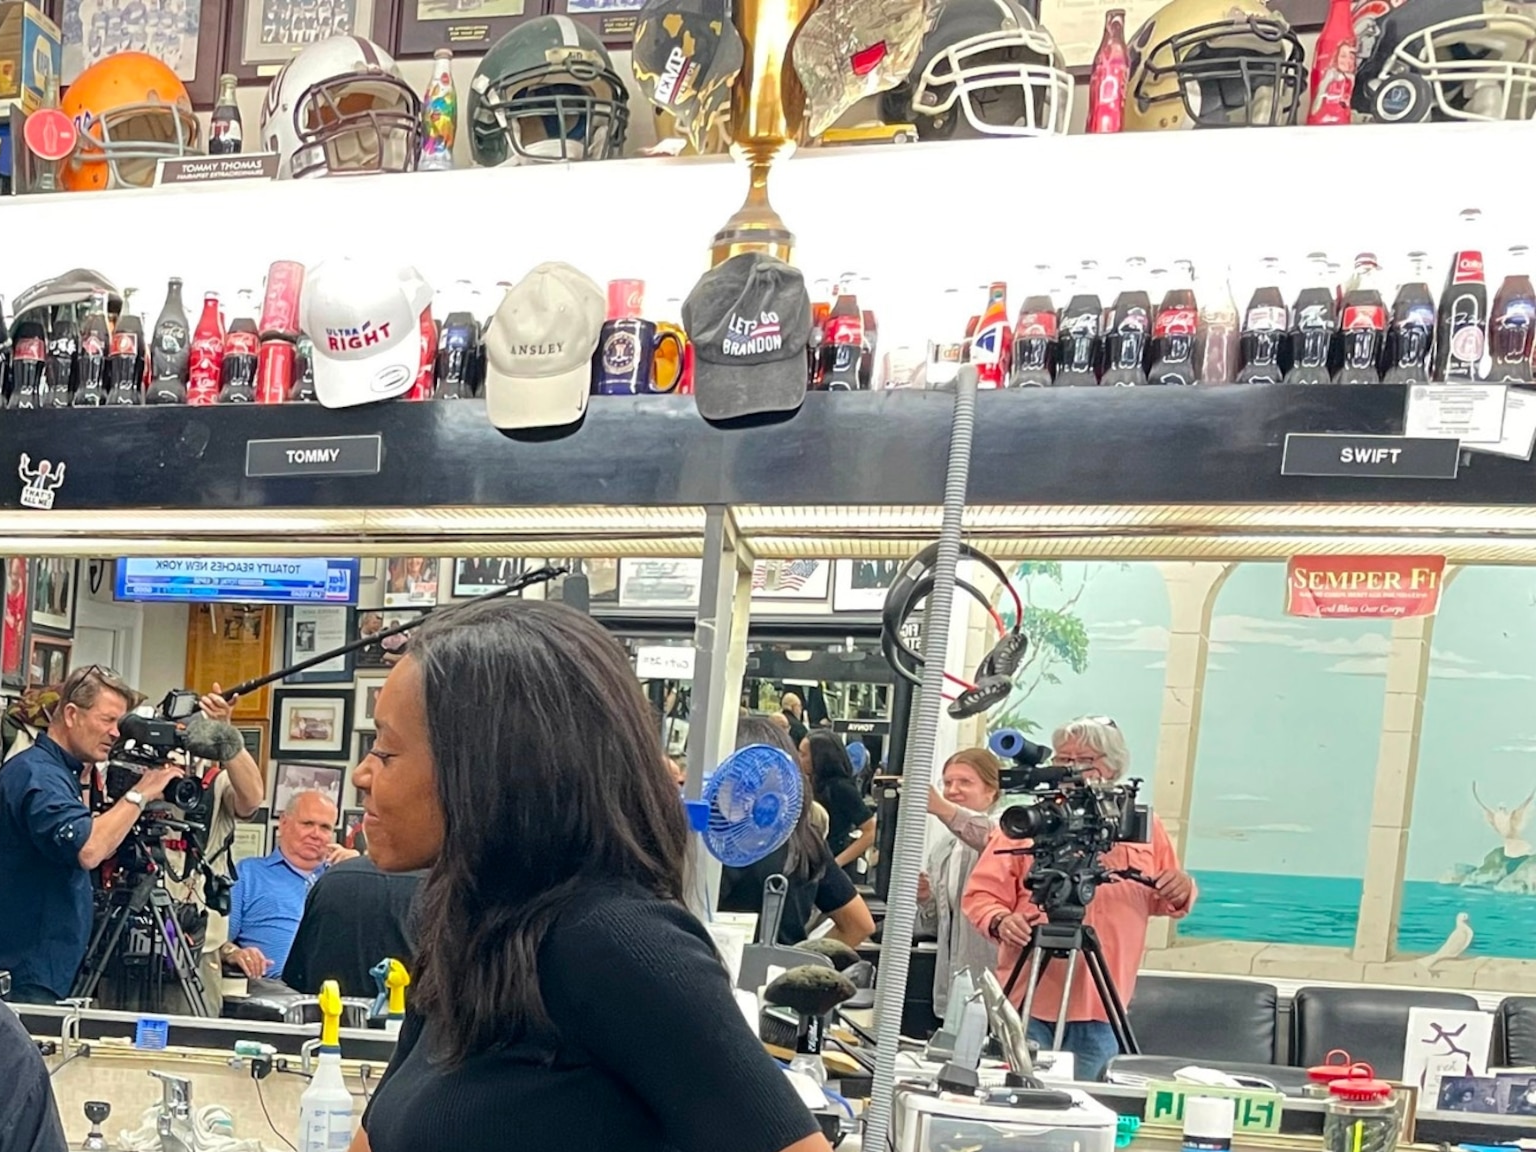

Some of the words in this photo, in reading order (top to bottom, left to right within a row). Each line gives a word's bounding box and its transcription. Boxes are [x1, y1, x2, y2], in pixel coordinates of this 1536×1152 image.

[182, 162, 219, 174] TOMMY
[220, 160, 262, 171] THOMAS
[760, 311, 780, 326] GO
[326, 327, 359, 338] ULTRA
[328, 322, 391, 351] RIGHT
[509, 343, 564, 356] ANSLEY
[722, 335, 783, 356] BRANDON
[286, 448, 340, 464] TOMMY
[1339, 448, 1402, 463] SWIFT
[1294, 567, 1402, 590] SEMPER
[1409, 567, 1437, 590] FI
